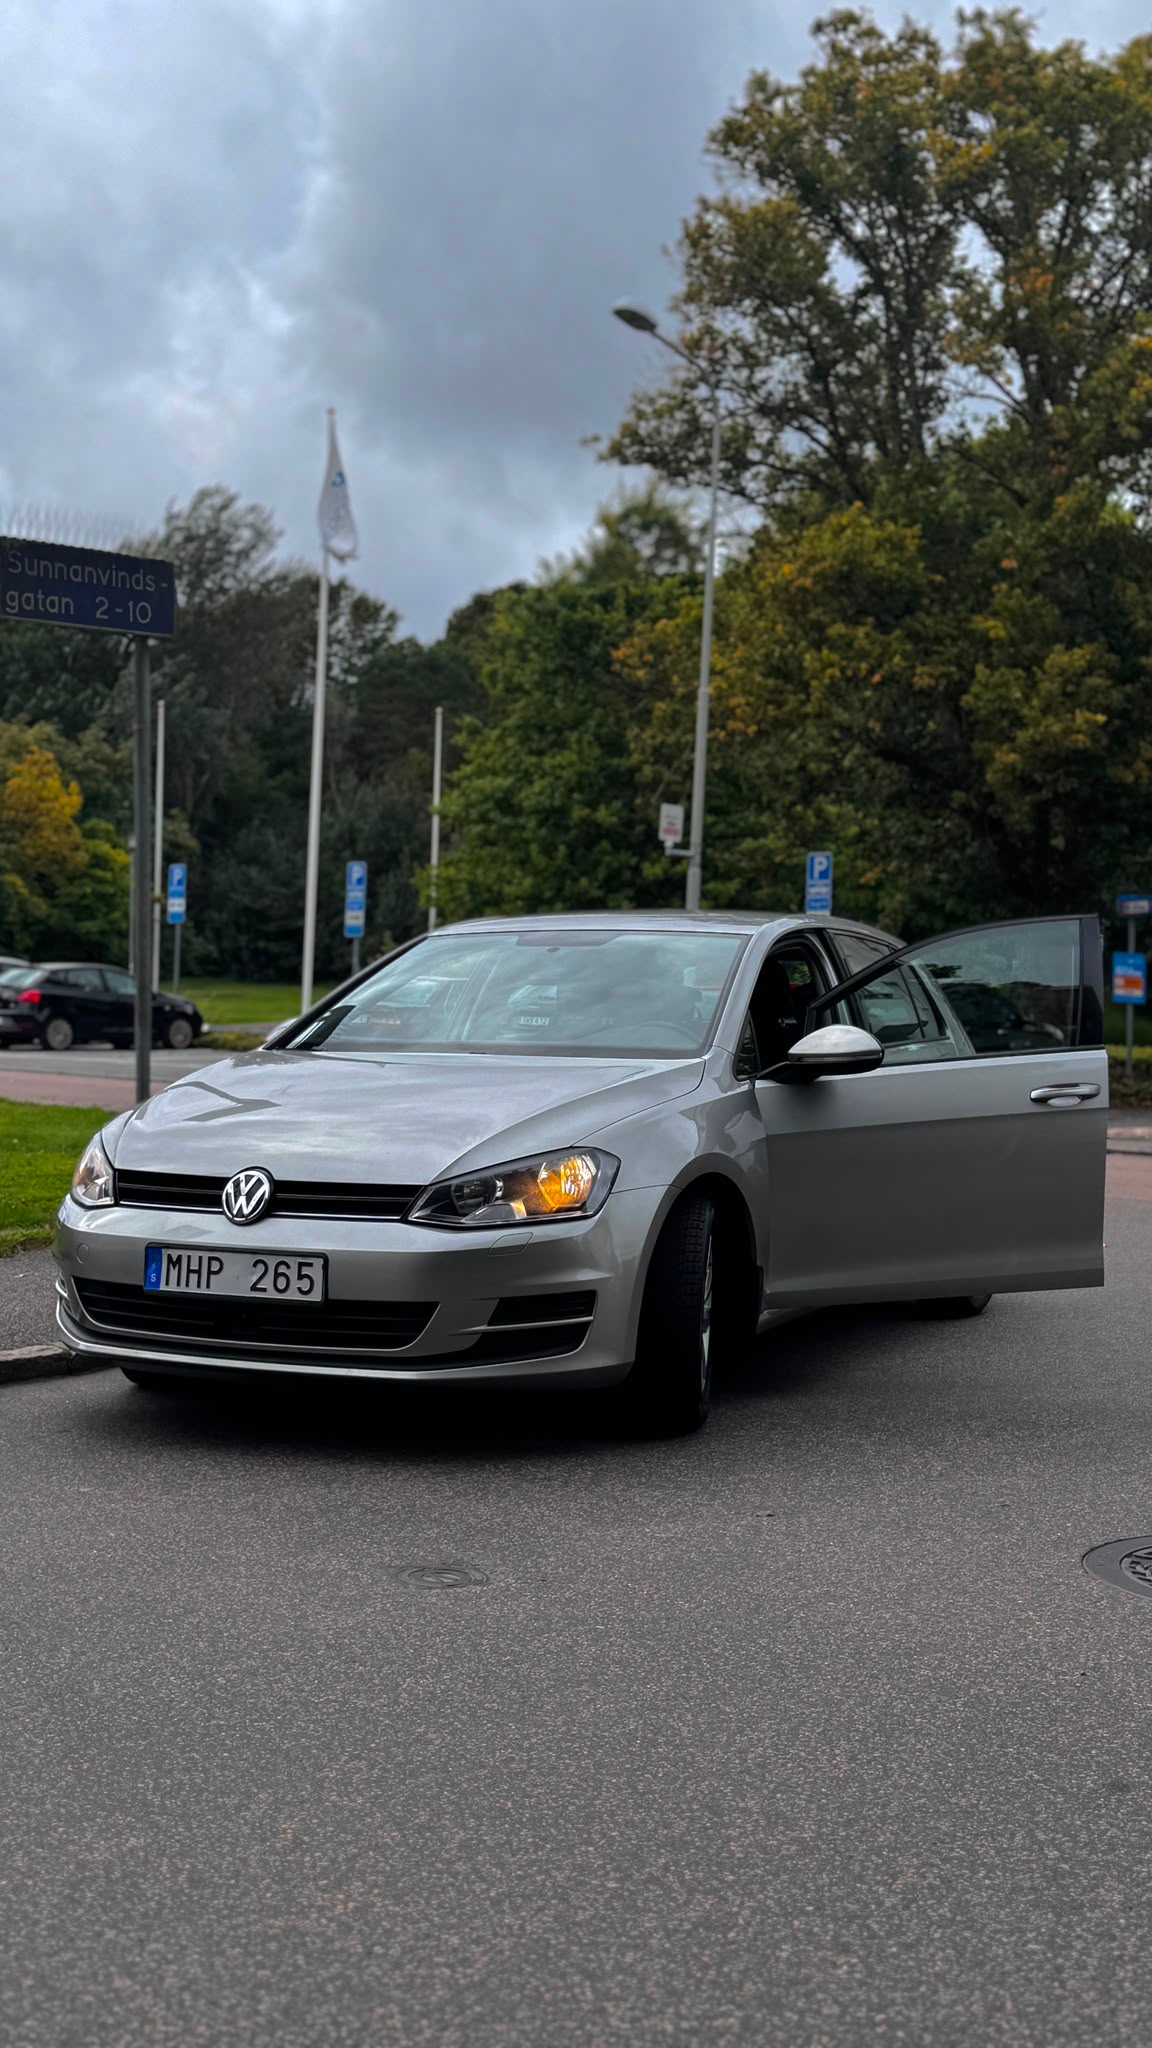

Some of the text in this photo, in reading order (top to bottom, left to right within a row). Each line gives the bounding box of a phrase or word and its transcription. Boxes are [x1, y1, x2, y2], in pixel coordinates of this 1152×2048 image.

[7, 550, 168, 592] Sunnanvinds-
[5, 590, 152, 624] gatan 2-10
[813, 856, 828, 880] P
[150, 1273, 157, 1282] S
[165, 1253, 315, 1296] MHP 265
